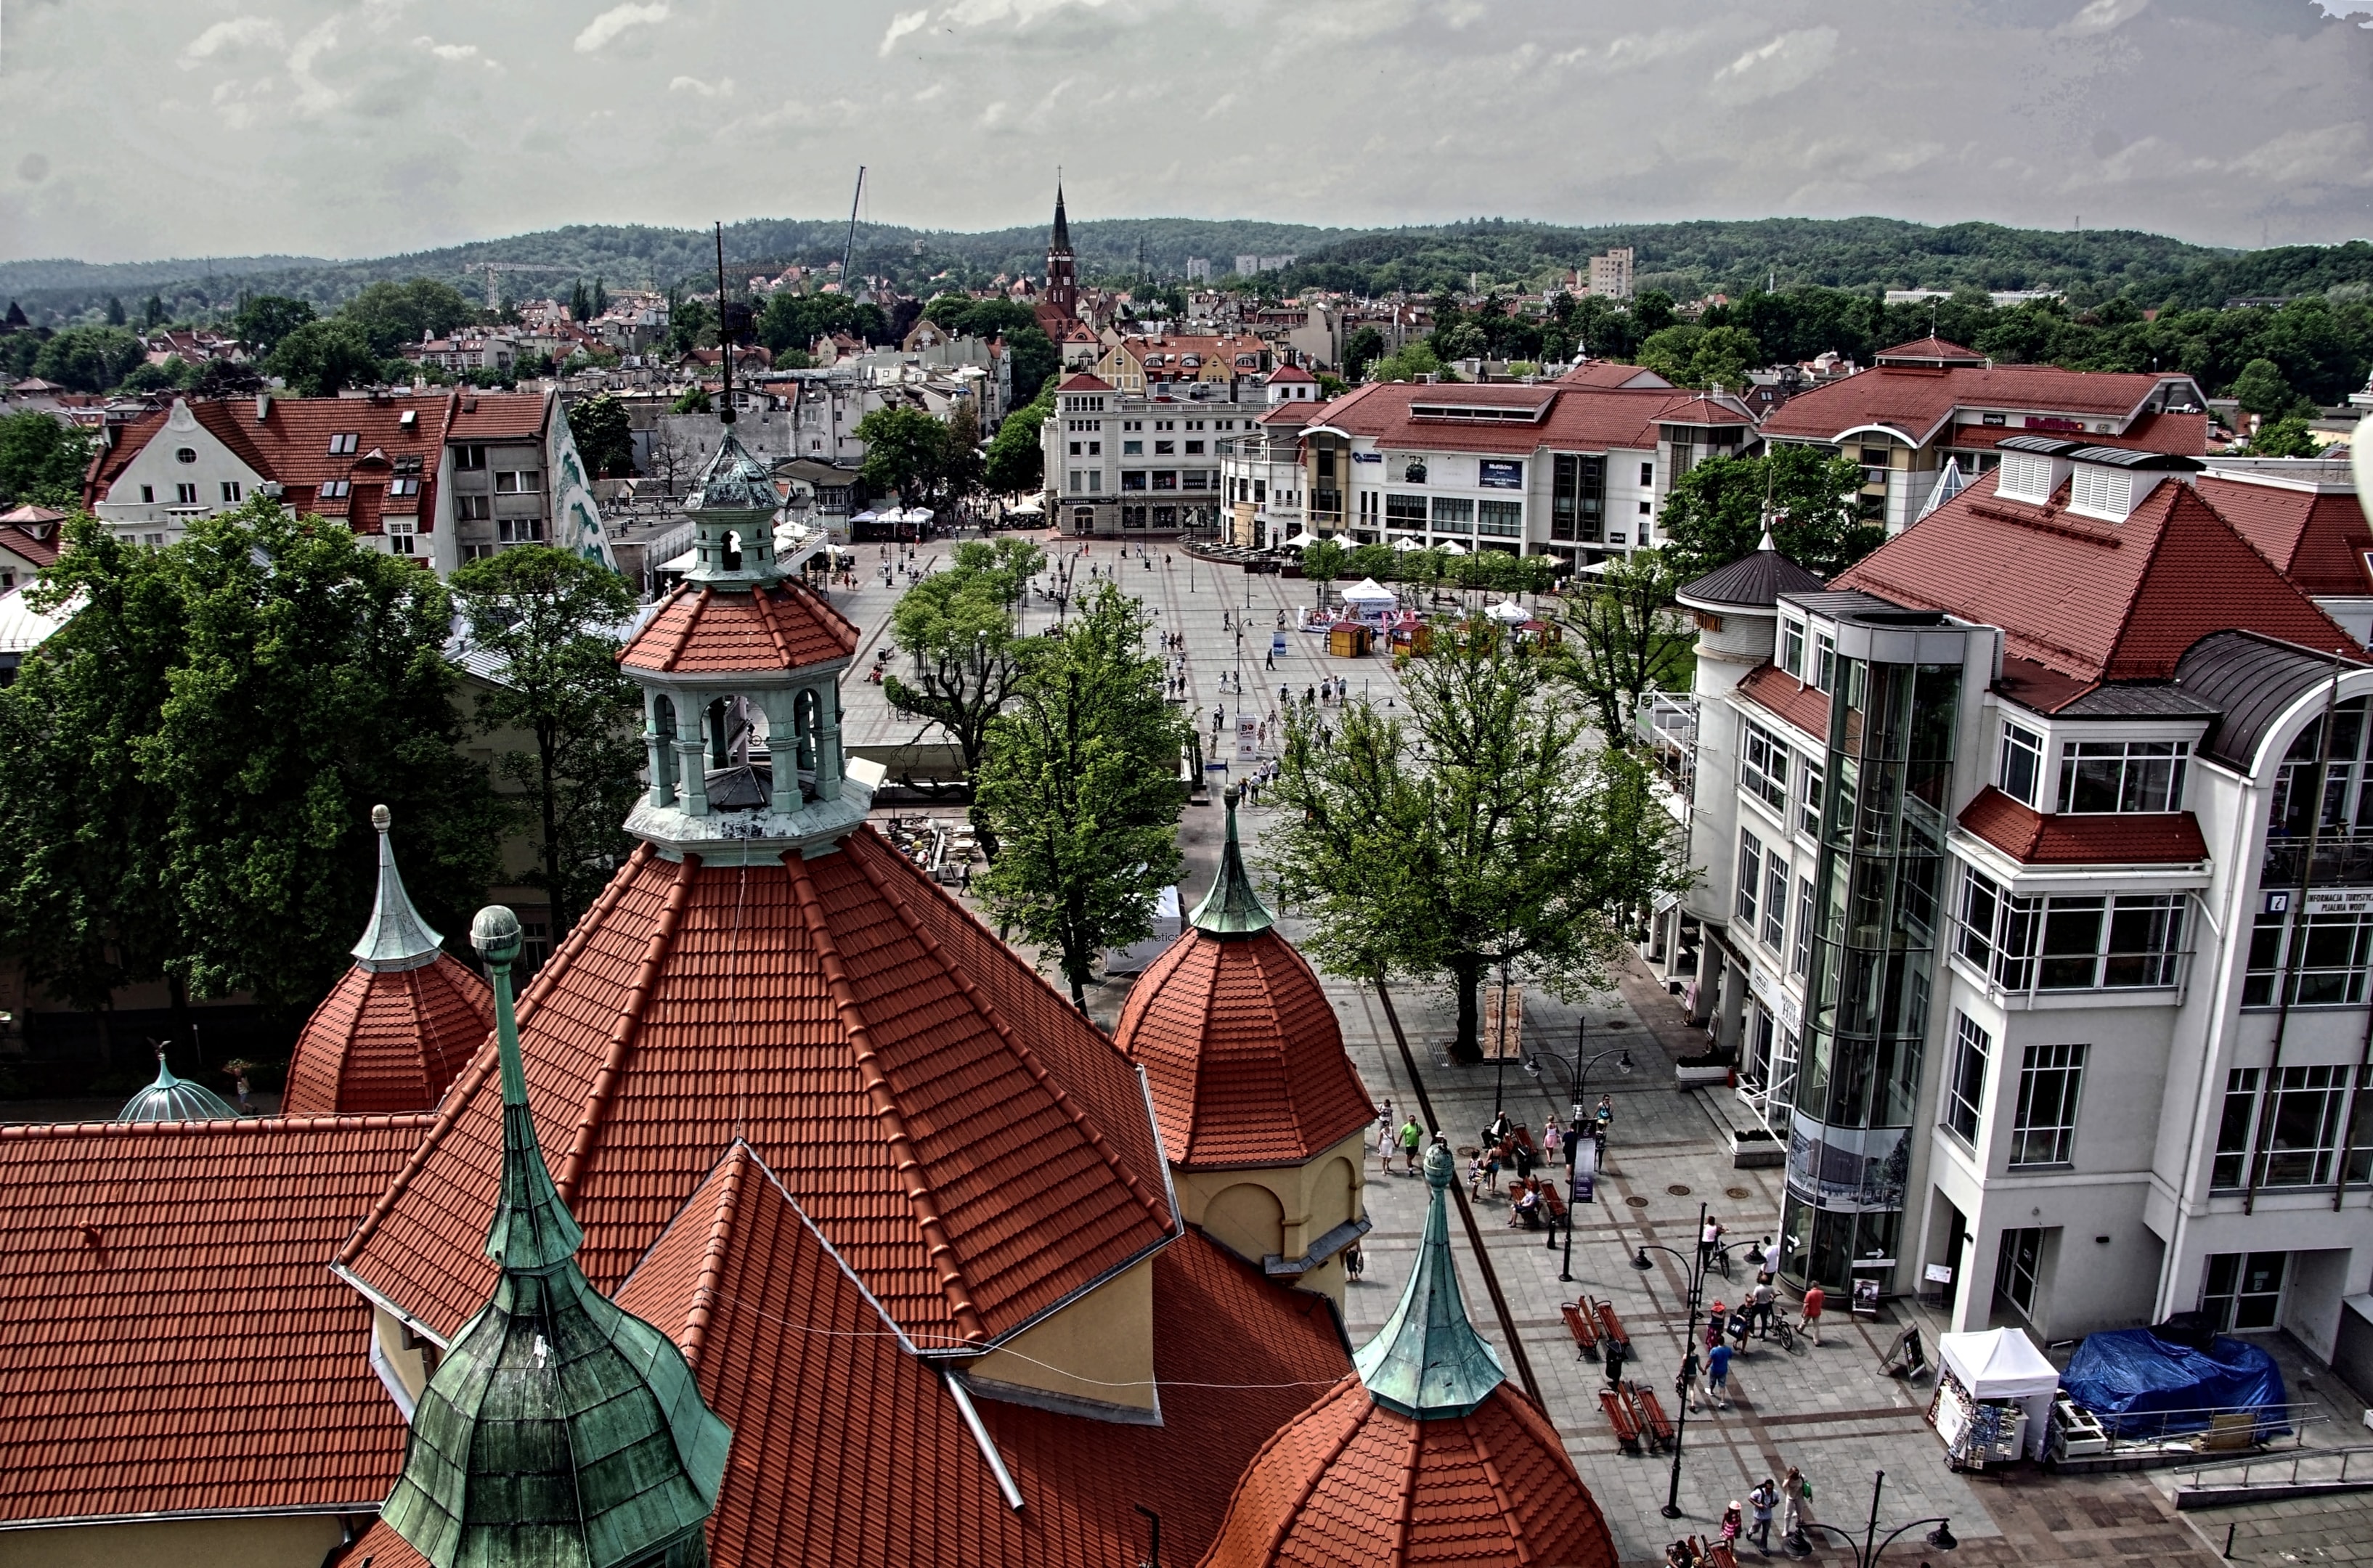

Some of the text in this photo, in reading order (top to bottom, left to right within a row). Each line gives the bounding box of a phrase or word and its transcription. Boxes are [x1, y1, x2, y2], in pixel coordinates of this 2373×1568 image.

[1984, 416, 2004, 425] empik
[2307, 894, 2343, 902] INFORMACJA
[2321, 902, 2366, 912] PIJALNIA WODY
